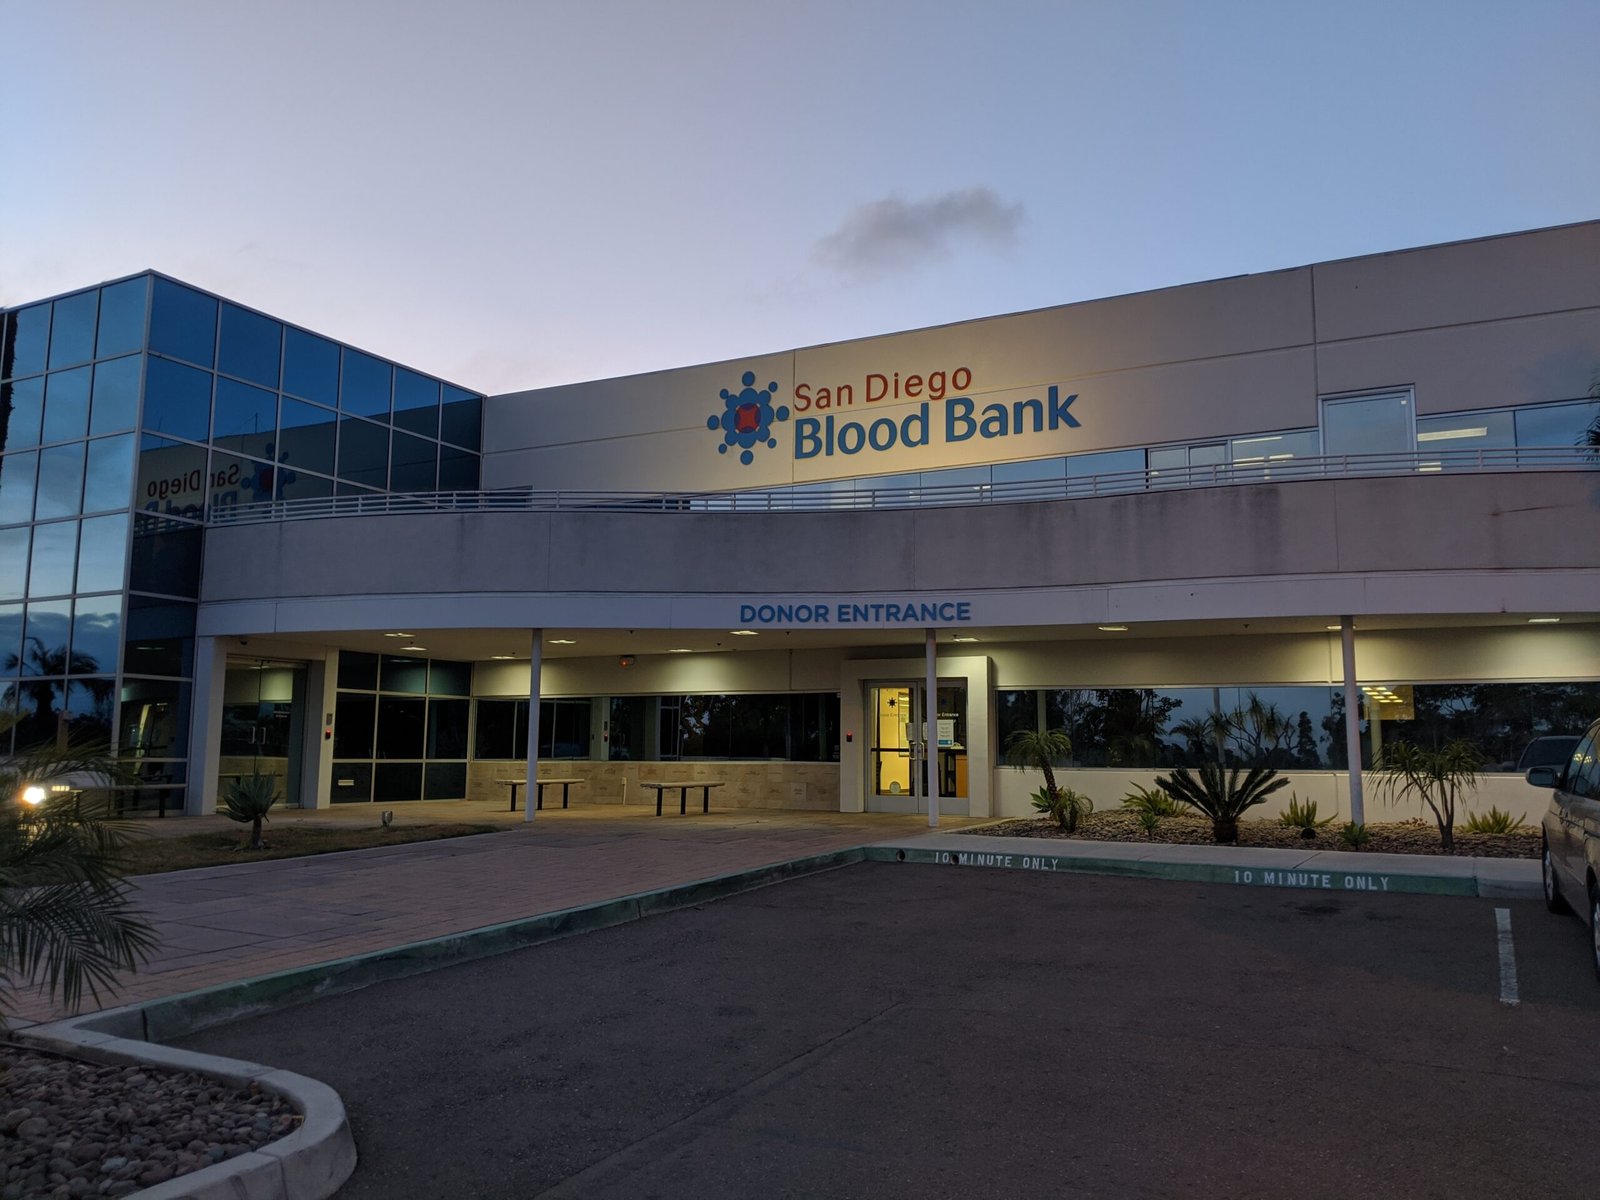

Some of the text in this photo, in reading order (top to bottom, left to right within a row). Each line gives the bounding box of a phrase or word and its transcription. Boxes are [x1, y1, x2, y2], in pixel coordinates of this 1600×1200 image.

[794, 366, 972, 412] San Diego
[794, 385, 1082, 459] Blood Bank
[740, 602, 971, 623] DONOR ENTRANCE
[935, 852, 1059, 871] 10 MINUTE ONLY
[1234, 870, 1389, 891] 10 MINUTE ONLY
